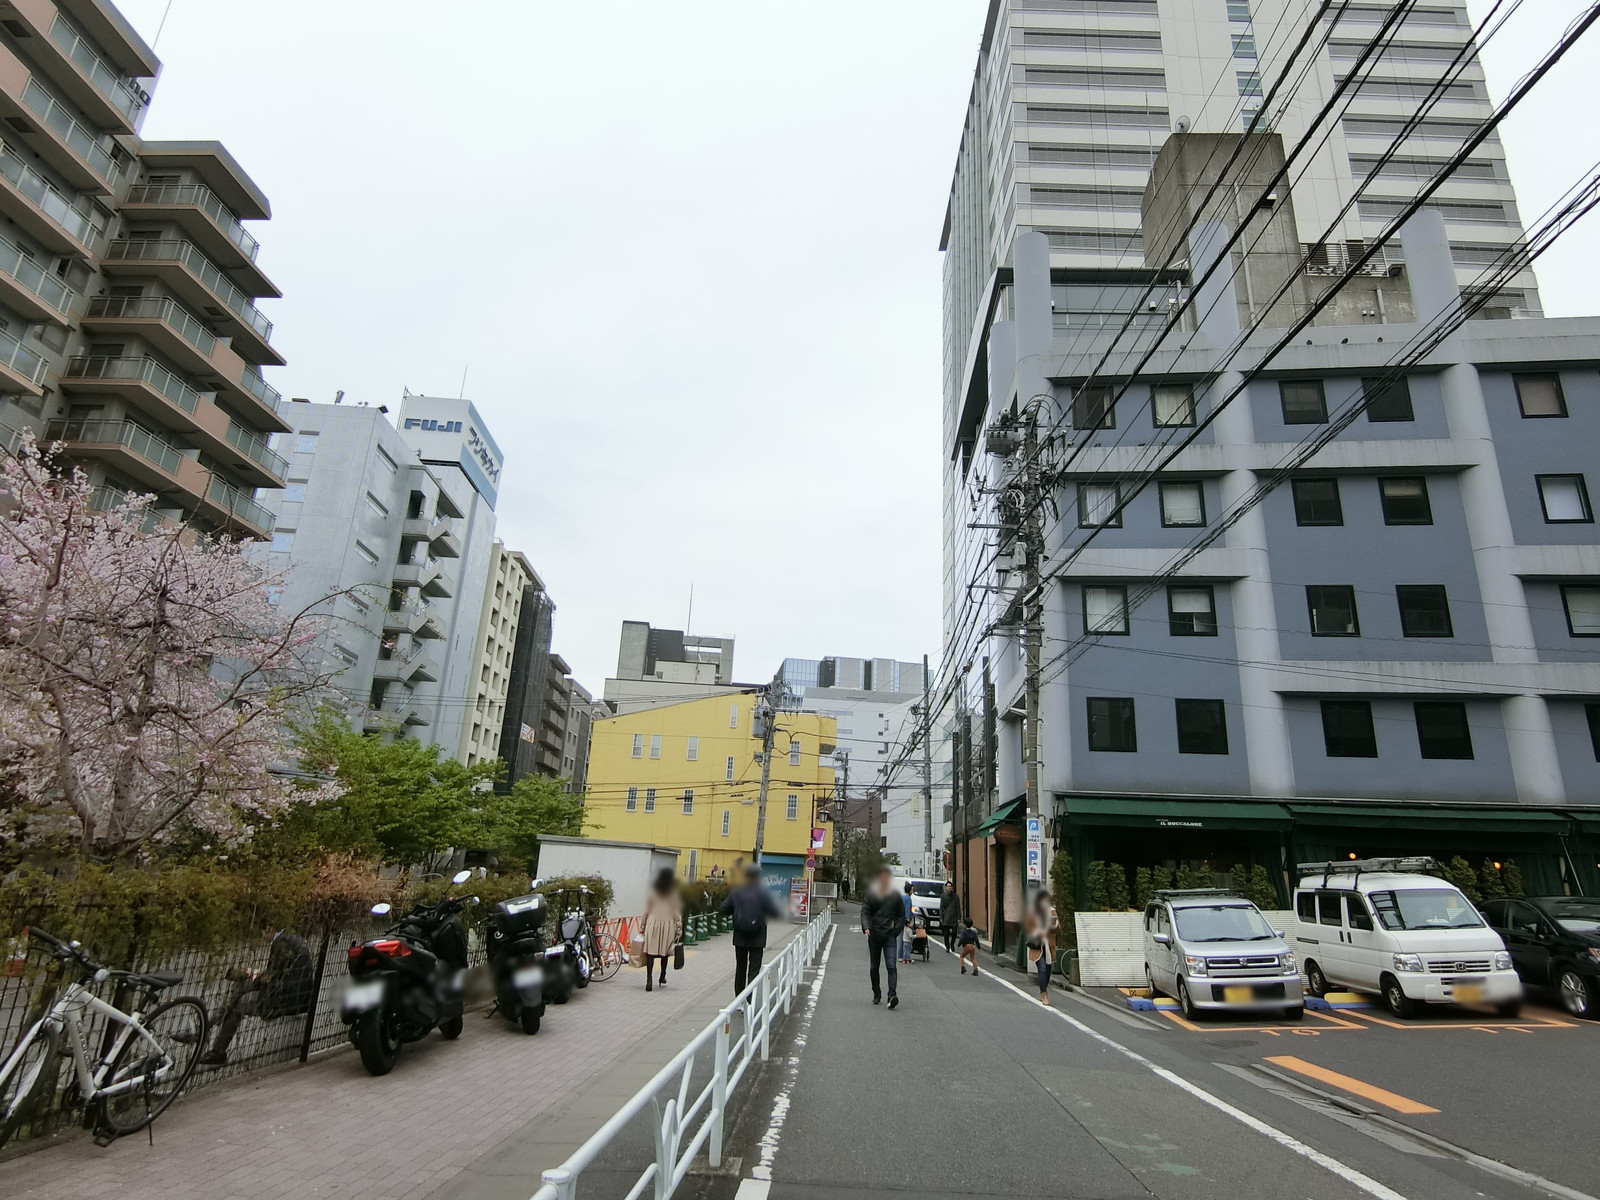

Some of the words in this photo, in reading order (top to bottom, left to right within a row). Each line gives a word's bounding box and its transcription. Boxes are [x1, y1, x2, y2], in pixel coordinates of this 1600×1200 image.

[404, 418, 462, 433] FUJI
[468, 426, 499, 484] フジキカイ
